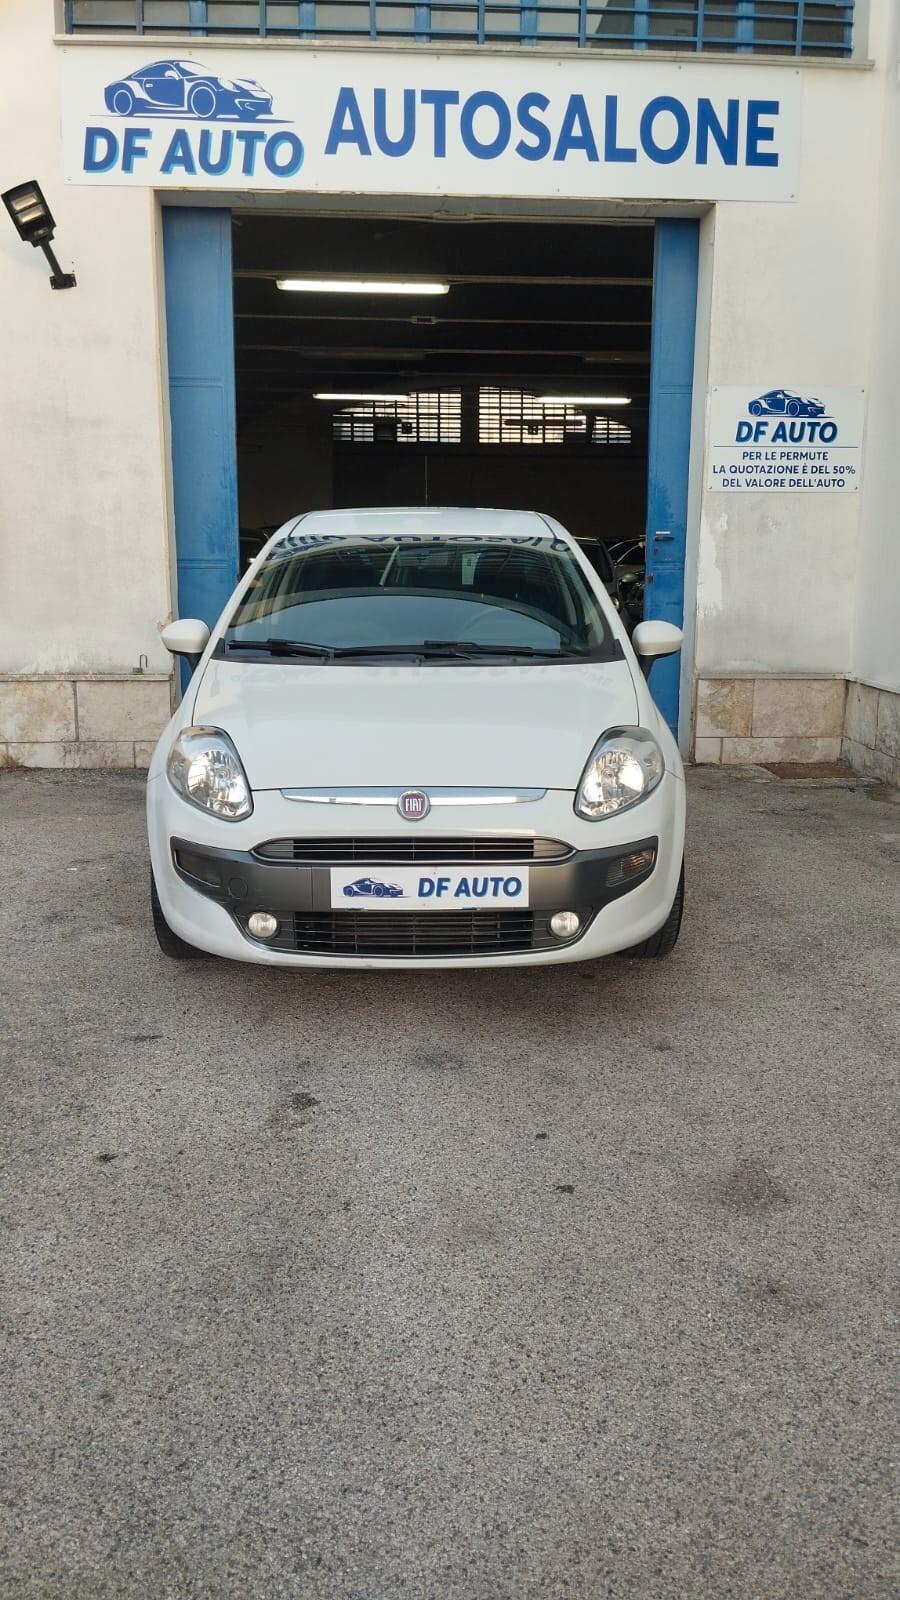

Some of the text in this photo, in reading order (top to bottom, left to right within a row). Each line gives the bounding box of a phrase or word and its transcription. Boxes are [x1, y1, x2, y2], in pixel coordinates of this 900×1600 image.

[325, 87, 780, 167] AUTOSALONE
[83, 127, 304, 178] DF AUTO
[735, 421, 838, 443] DF AUTO
[742, 452, 829, 461] PER LE PERMUTE
[712, 465, 726, 474] LA
[729, 465, 799, 475] QUOTAZIONE
[811, 465, 830, 475] DEL
[833, 465, 856, 475] 50%
[722, 479, 845, 488] DEL VALORE DELL'AUTO
[405, 798, 423, 811] FIAT
[418, 877, 522, 898] DF AUTO
